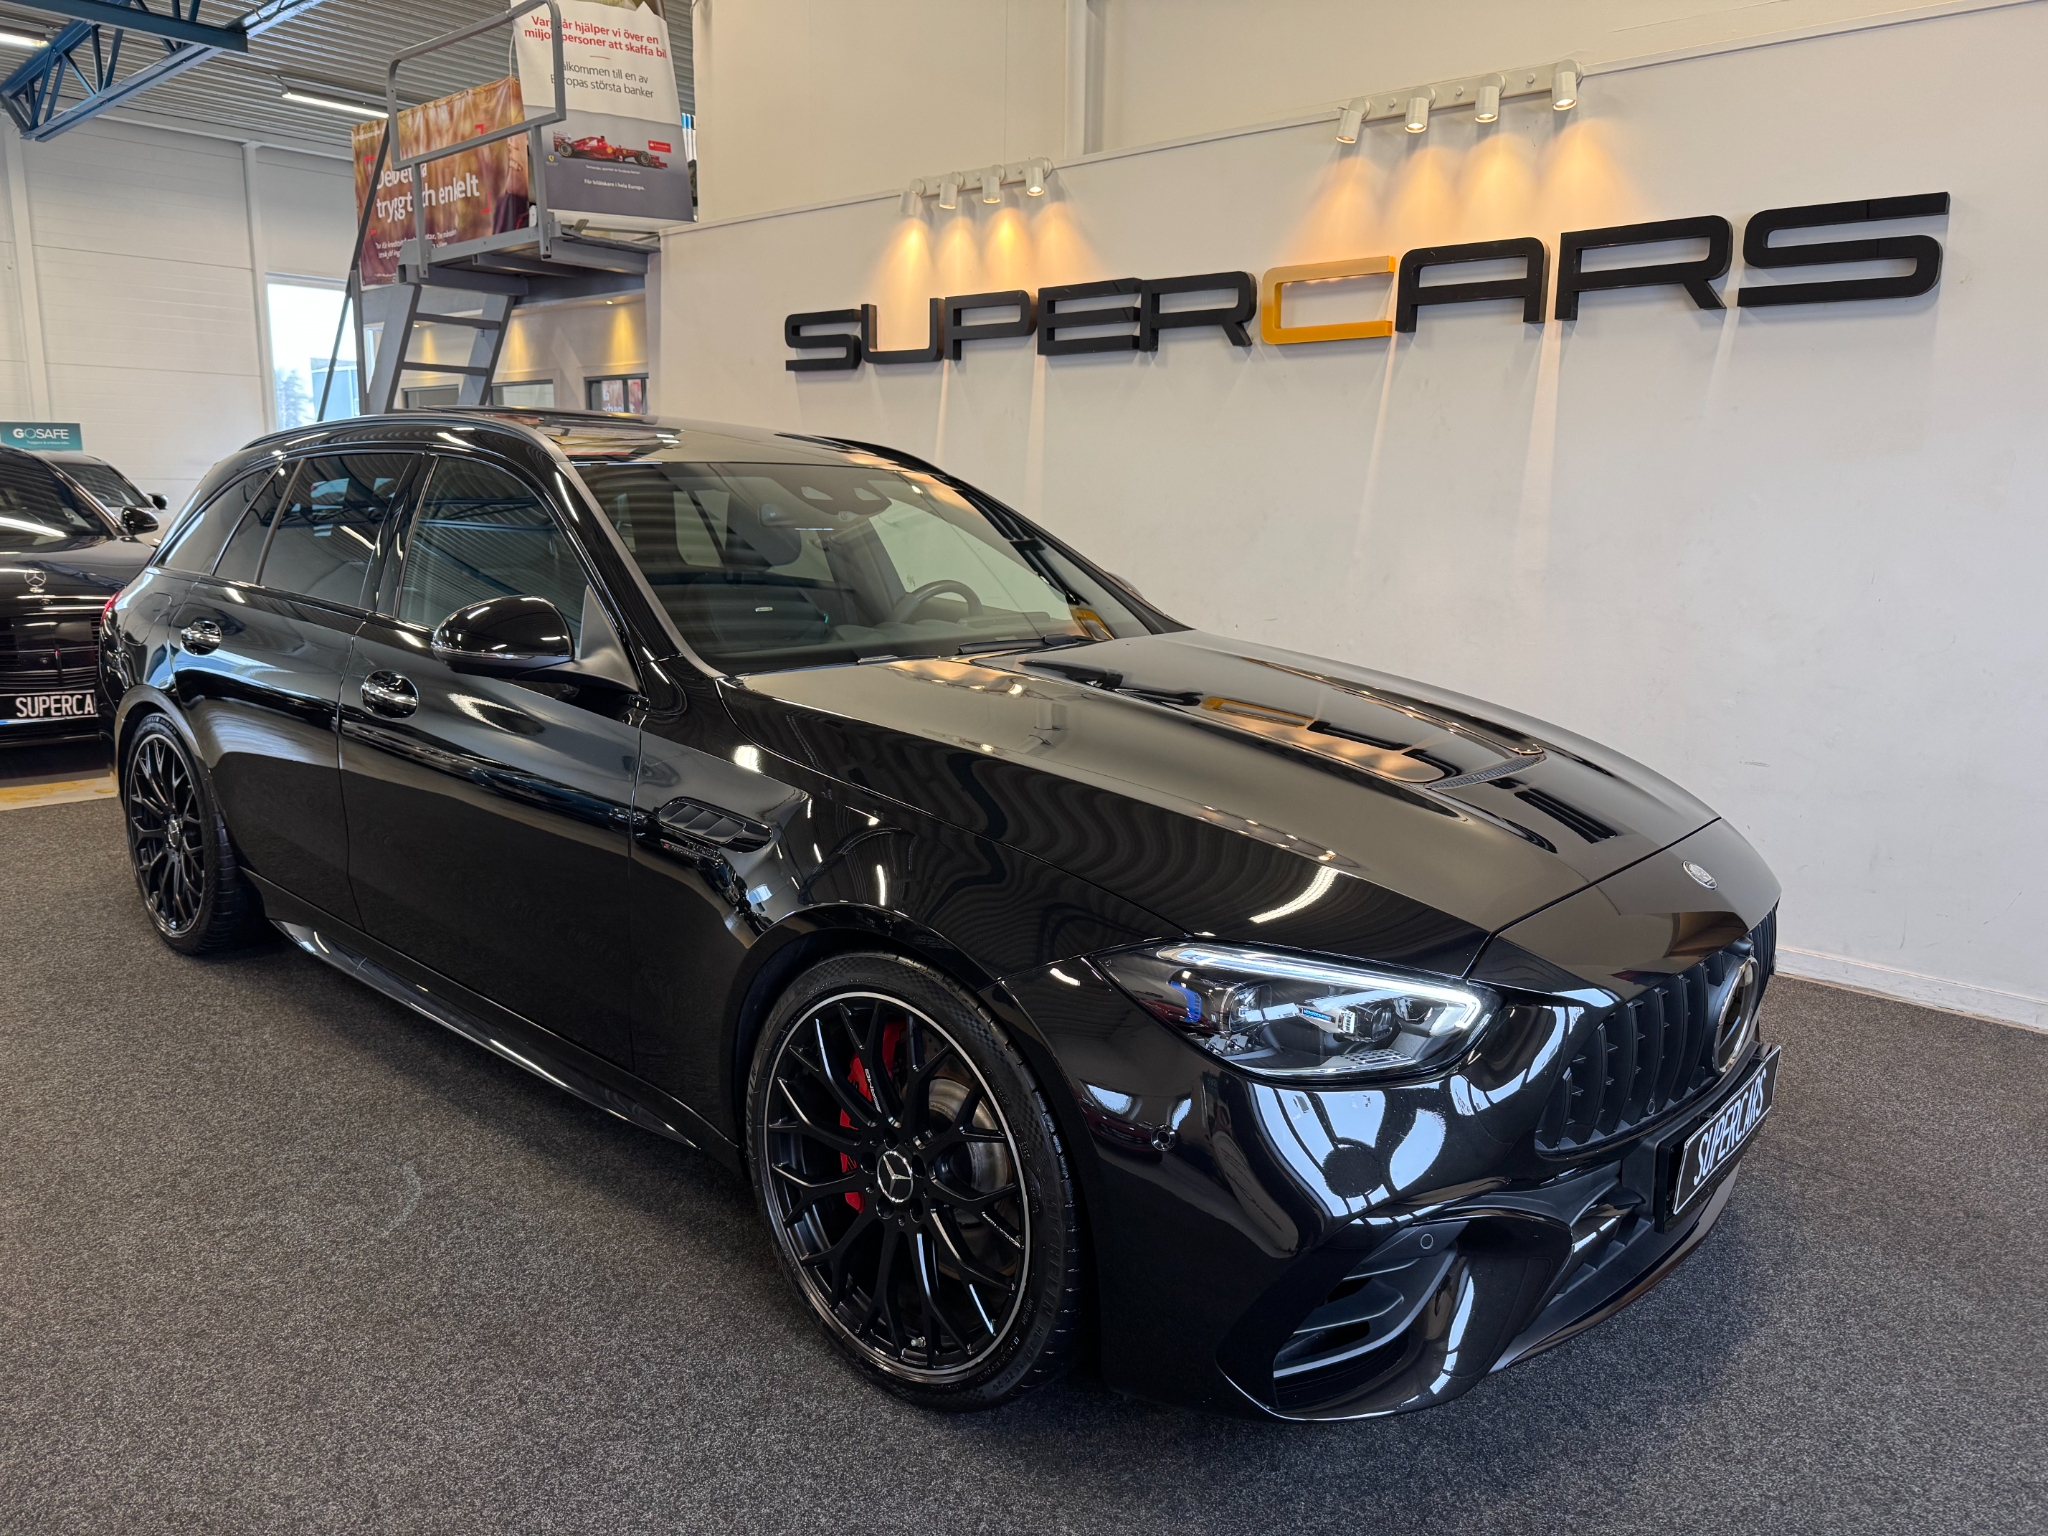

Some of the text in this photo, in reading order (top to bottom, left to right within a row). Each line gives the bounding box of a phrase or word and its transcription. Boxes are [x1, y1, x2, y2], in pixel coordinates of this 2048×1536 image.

[524, 28, 667, 59] miljo personer att skaffa bil
[531, 16, 659, 45] Var år hjälper vi över en
[562, 61, 649, 84] älkommen till en av
[590, 80, 622, 93] största
[624, 83, 654, 98] banker
[438, 172, 480, 205] enkelt
[785, 191, 1950, 371] SUPERCARS
[12, 427, 70, 440] GOSAFE
[1693, 1067, 1767, 1186] SUPERCARS
